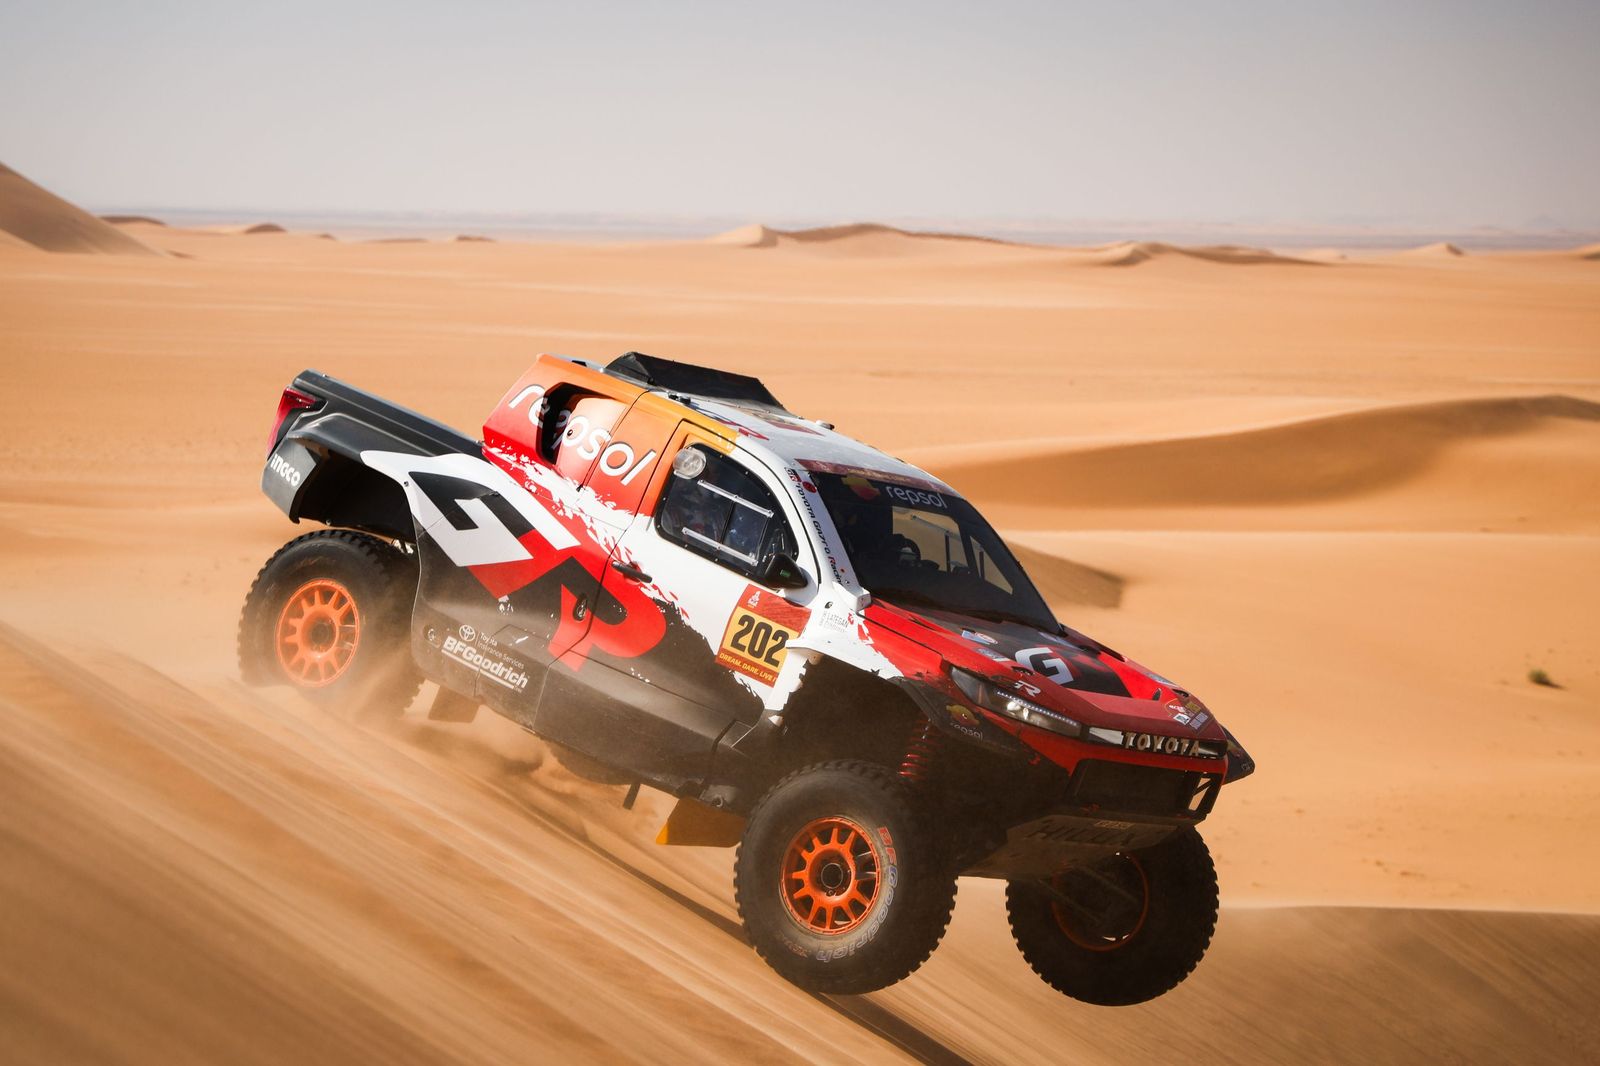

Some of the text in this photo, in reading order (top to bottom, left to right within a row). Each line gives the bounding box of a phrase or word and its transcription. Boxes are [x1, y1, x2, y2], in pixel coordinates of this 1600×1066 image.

[795, 482, 816, 519] TOYOTA
[886, 486, 948, 509] repsol
[730, 614, 789, 667] 202
[443, 635, 529, 688] BFGoodrich
[502, 653, 525, 670] Services
[1124, 732, 1200, 757] TOYOTA
